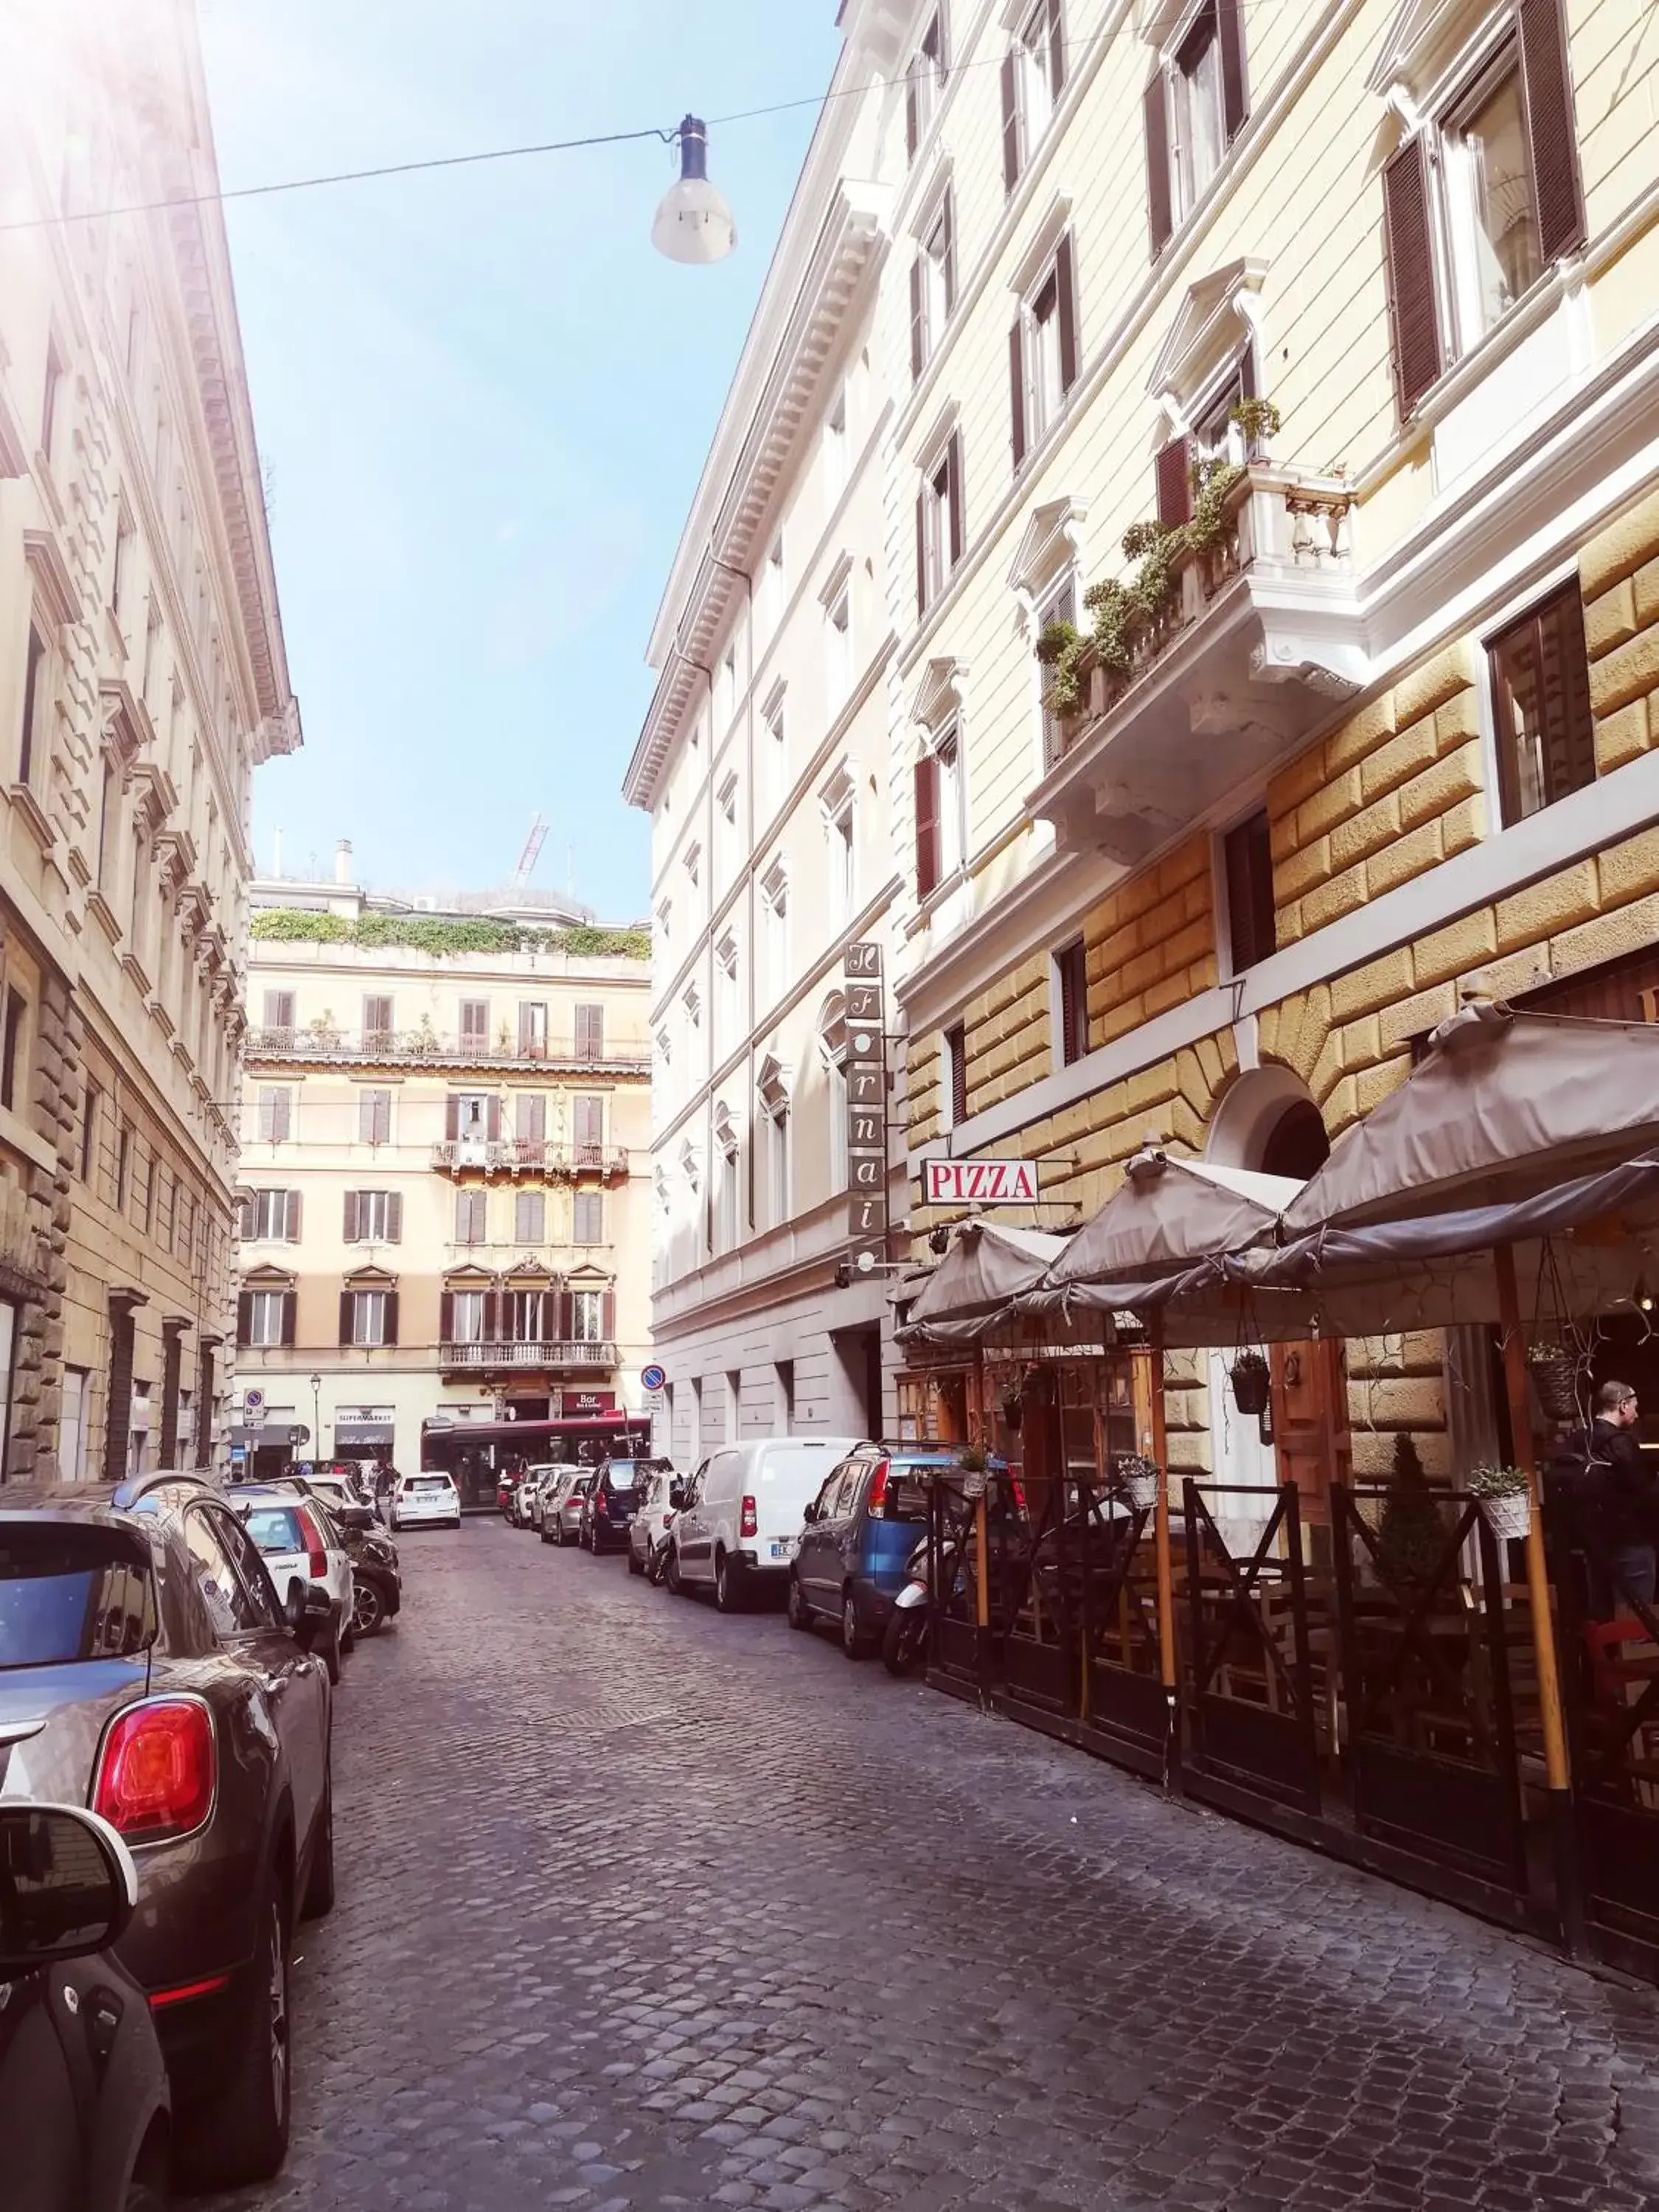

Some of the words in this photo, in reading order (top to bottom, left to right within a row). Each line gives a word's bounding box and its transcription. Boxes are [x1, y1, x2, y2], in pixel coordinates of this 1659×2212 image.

[849, 945, 876, 971] Il
[851, 987, 879, 1272] Fornaio
[931, 1165, 1035, 1198] PIZZA
